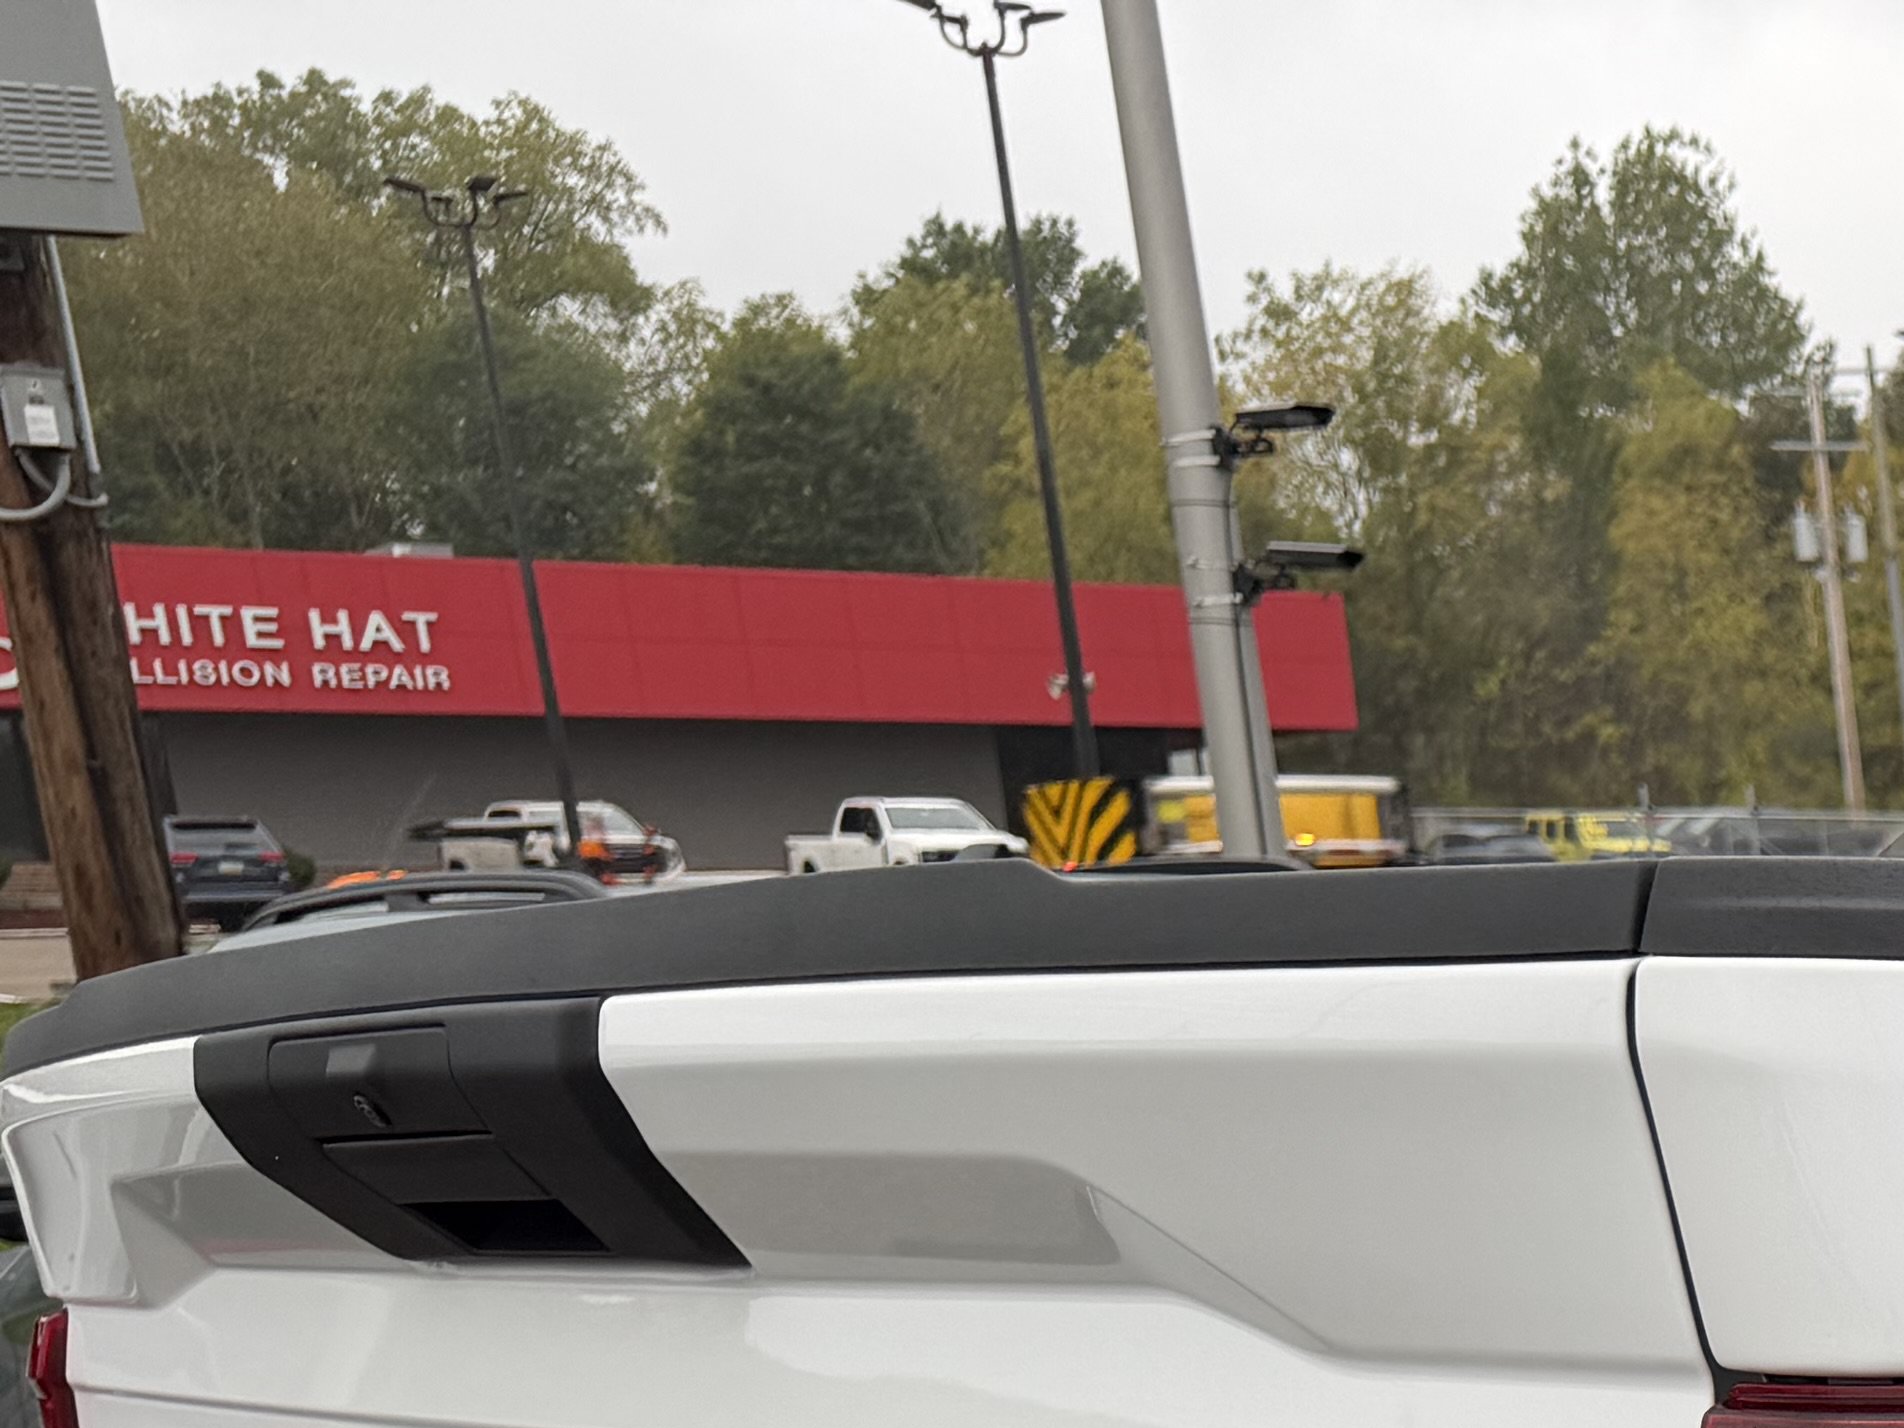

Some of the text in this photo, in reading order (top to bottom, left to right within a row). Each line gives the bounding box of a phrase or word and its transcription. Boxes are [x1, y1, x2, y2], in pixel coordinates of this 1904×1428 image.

[124, 602, 439, 654] HITE HAT
[130, 657, 451, 691] LLISION REPAIR
